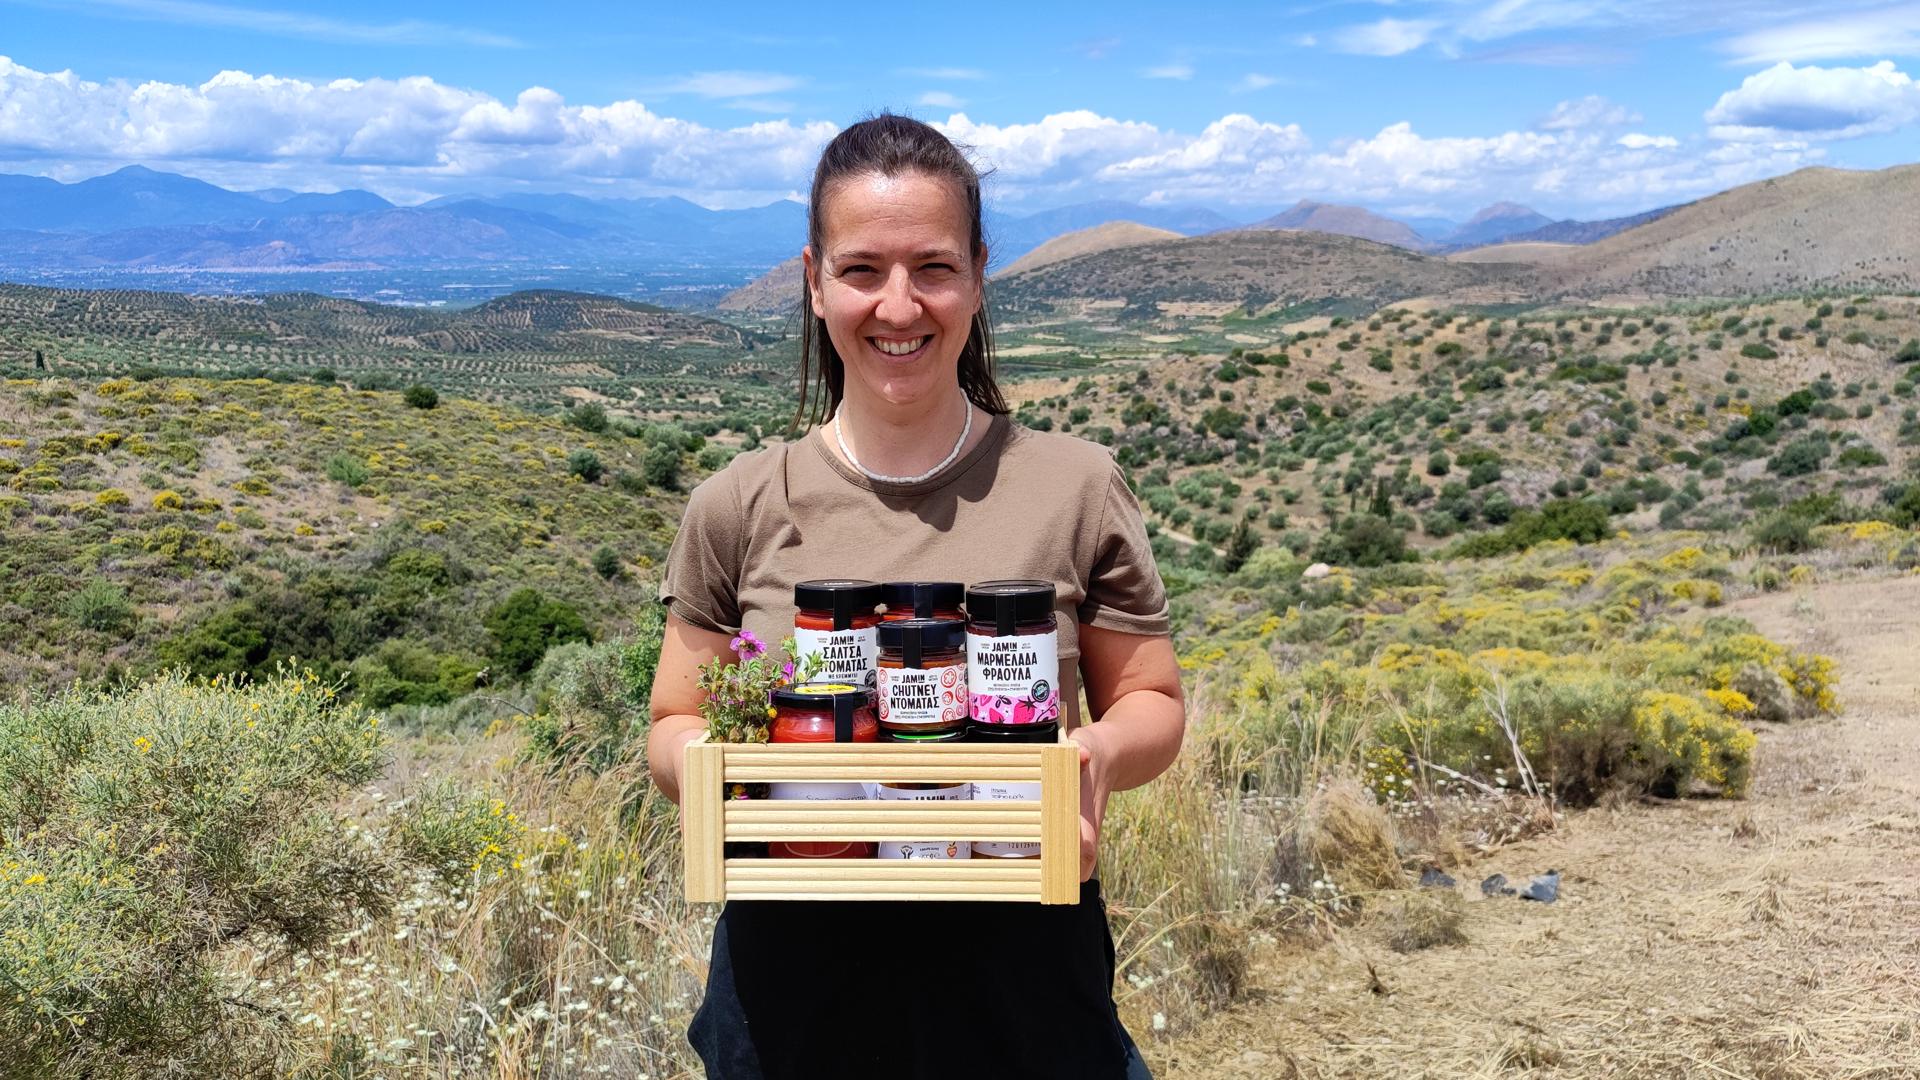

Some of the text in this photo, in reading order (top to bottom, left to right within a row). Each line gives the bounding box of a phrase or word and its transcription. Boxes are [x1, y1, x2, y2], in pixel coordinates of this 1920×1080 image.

[829, 635, 854, 646] JAMIN
[991, 642, 1018, 652] JAMIN
[823, 645, 862, 659] ΣΑΛΤΣΑ
[820, 658, 868, 673] ΤΟΜΑΤΑΣ
[977, 652, 1038, 667] ΜΑΡΜΕΛΑΔΑ
[901, 674, 926, 684] JAMIN
[982, 667, 1032, 681] ΦΡΑΟΥΛΑ
[892, 684, 937, 697] CHUTNEY
[890, 697, 940, 710] ΝΤΟΜΑΤΑΣ
